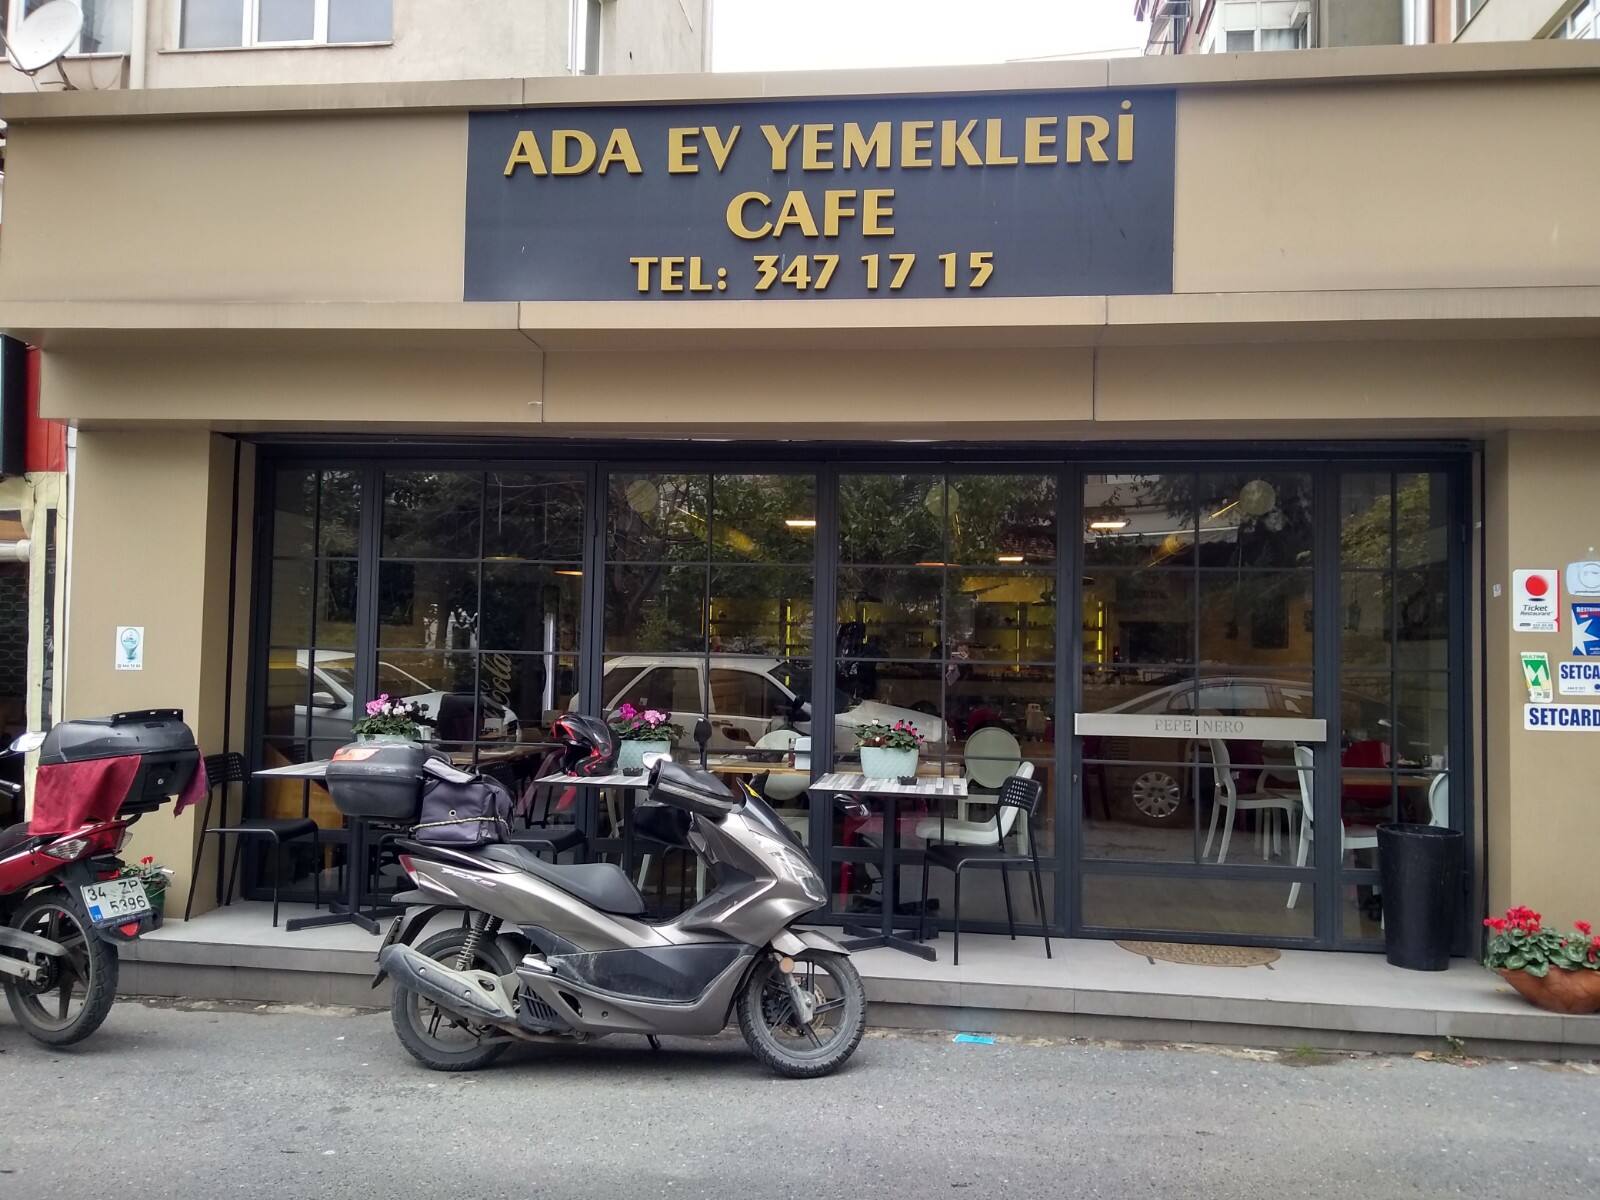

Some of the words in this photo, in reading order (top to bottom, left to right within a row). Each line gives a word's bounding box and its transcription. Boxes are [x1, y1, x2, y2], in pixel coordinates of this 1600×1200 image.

[504, 128, 643, 177] ADA
[668, 125, 741, 174] EV
[760, 99, 1134, 172] YEMEKLERİ
[726, 188, 895, 240] CAFE
[629, 256, 728, 293] TEL:
[753, 254, 840, 291] 347
[861, 253, 916, 290] 17
[938, 251, 994, 290] 15
[1523, 604, 1548, 612] Ticket
[1154, 719, 1191, 732] PEPE
[1203, 720, 1244, 734] NERO
[1529, 707, 1600, 727] SETCARD
[87, 887, 106, 901] 34
[109, 895, 146, 913] 5396
